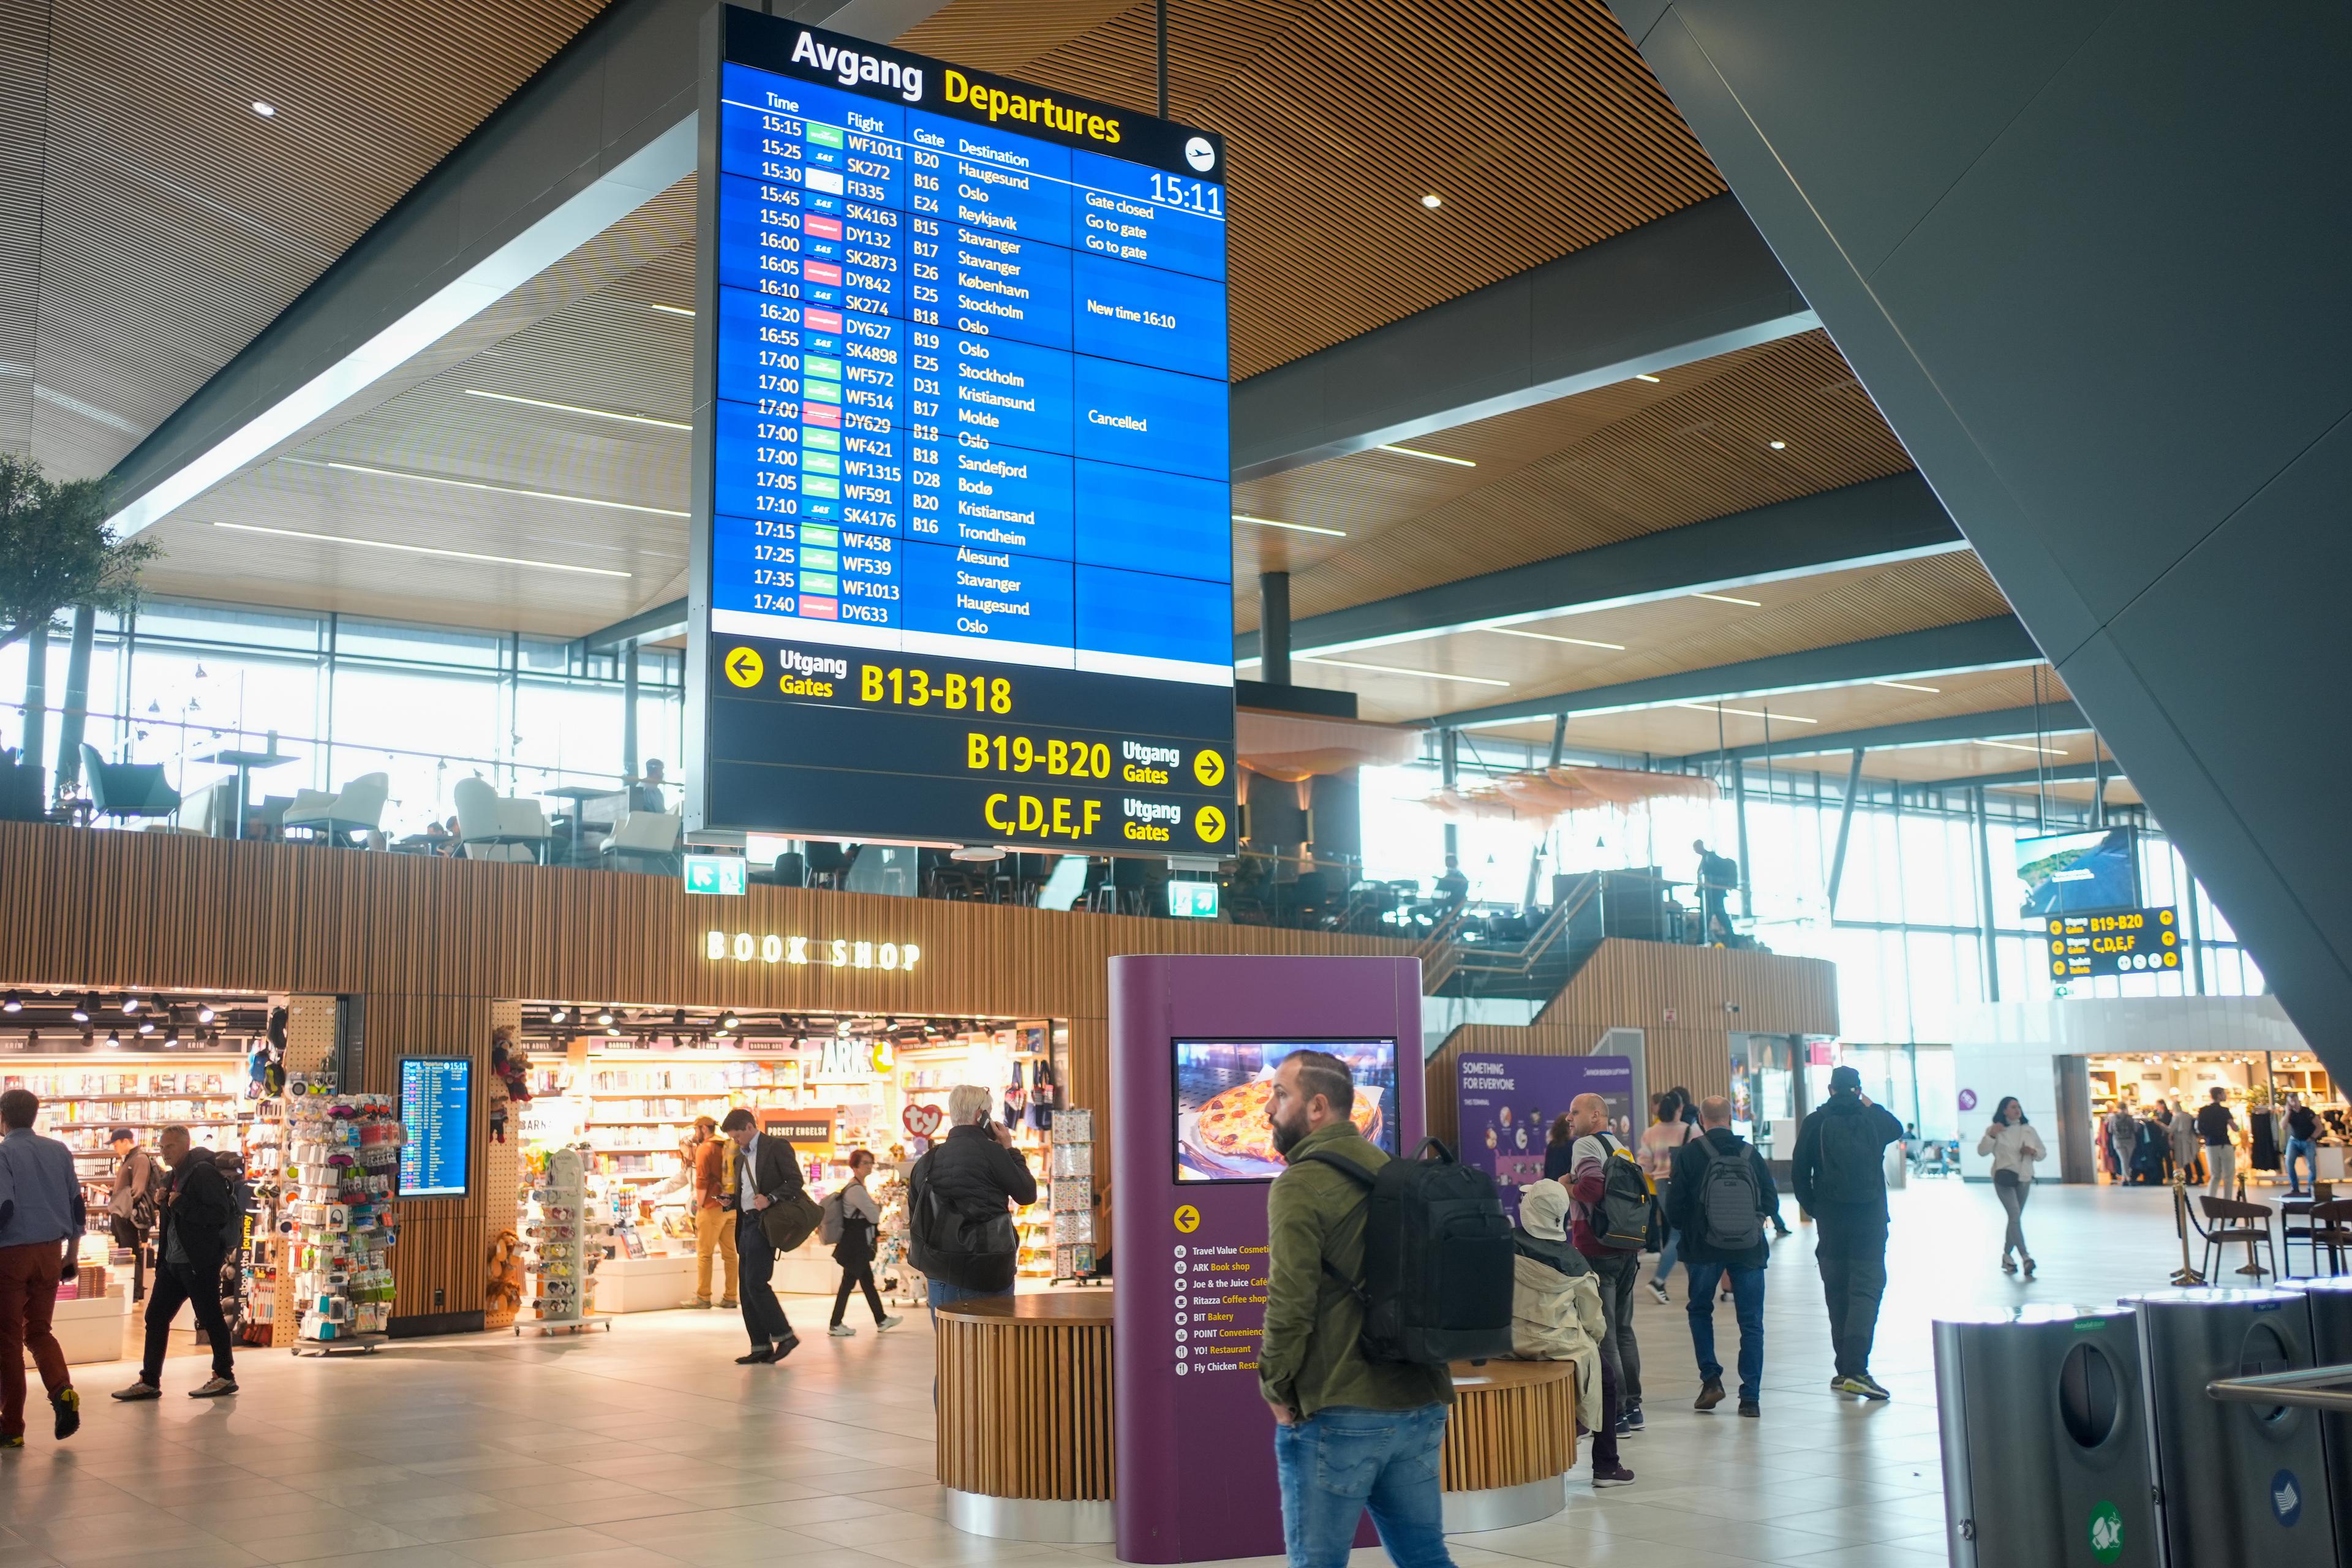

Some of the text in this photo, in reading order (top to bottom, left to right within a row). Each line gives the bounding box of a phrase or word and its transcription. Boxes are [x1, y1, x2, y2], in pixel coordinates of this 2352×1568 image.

[791, 31, 1121, 143] Avgang Departures
[767, 92, 1028, 167] Time Flight Gate Destination
[763, 116, 801, 136] 15:15
[848, 135, 903, 160] WF1011
[915, 151, 939, 168] B20
[959, 162, 1029, 189] Haugesund
[1086, 192, 1114, 209] Gate
[1117, 201, 1154, 219] closed
[763, 139, 1147, 238] 15:25 SK272 B16 Oslo Go to gate
[763, 162, 1147, 259] 15:30 FI335 E24 Reykjavik Go to gate
[1150, 173, 1223, 216] 15:11
[761, 186, 1020, 254] 15:45 SK4163 B15 Stavanger
[761, 209, 799, 228] 15:50
[847, 227, 891, 248] DY132
[914, 241, 938, 257] B17
[959, 251, 1020, 276] Stavanger
[761, 232, 1175, 328] 16:00 SK2873 E26 København New time 16:10
[761, 255, 799, 274] 16:05
[846, 272, 890, 293] DY842
[914, 285, 938, 302] E25
[959, 295, 1023, 319] Stockholm
[760, 279, 989, 334] 16:10 SK274 B18 Oslo
[761, 304, 799, 323] 16:20
[847, 319, 891, 339] DY627
[914, 332, 939, 349] B19
[959, 341, 989, 358] Oslo
[760, 327, 1024, 387] 16:55 SK4898 E25 Stockholm
[760, 351, 1147, 431] 17:00 WF572 D31 Kristiansund Cancelled
[760, 374, 799, 393] 17:00
[846, 389, 893, 410] WF514
[914, 401, 938, 417] B17
[959, 409, 999, 428] Molde
[759, 399, 798, 418] 17:00
[845, 413, 891, 433] DY629
[914, 424, 938, 441] B18
[959, 432, 989, 449] Oslo
[758, 424, 797, 442] 17:00
[845, 437, 892, 457] WF421
[914, 448, 938, 464] B18
[959, 455, 1027, 478] Sandefjord
[758, 448, 797, 466] 17:00
[845, 461, 901, 481] WF1315
[914, 470, 940, 487] D28
[959, 478, 992, 495] Bodø
[757, 472, 796, 490] 17:05
[845, 484, 892, 504] WF591
[914, 494, 938, 510] B20
[959, 500, 1035, 524] Kristiansand
[755, 521, 795, 539] 17:15
[843, 532, 891, 552] WF458
[957, 545, 1009, 567] Ålesund
[757, 496, 1025, 548] 17:10 SK4176 B16 Trondheim
[755, 545, 794, 563] 17:25
[843, 556, 891, 575] WF539
[957, 571, 1020, 593] Stavanger
[755, 570, 794, 587] 17:35
[843, 580, 899, 600] WF1013
[957, 594, 1030, 615] Haugesund
[755, 594, 794, 611] 17:40
[843, 604, 888, 622] DY633
[957, 617, 988, 633] Oslo
[780, 650, 846, 679] Utgang
[780, 665, 1011, 714] Gates B13-B18
[968, 733, 1179, 778] B19-B20 Utgang
[1123, 764, 1168, 784] Gates
[985, 794, 1180, 839] C,D,E,F Utgang
[1124, 822, 1169, 841] Gates
[2090, 914, 2143, 932] B19-B20
[707, 931, 920, 971] BOOK SHOP
[821, 1040, 872, 1073] ARK
[1463, 1062, 1504, 1075] SOMETHING
[1463, 1077, 1515, 1090] FOR EVERYONE
[767, 1126, 827, 1137] POCKET ENGELSK
[905, 1107, 938, 1135] ty
[241, 1215, 254, 1251] journey
[1193, 1246, 1215, 1255] Travel
[1239, 1245, 1269, 1254] Cosmeti
[1216, 1279, 1228, 1287] the
[1232, 1262, 1250, 1272] shop
[1208, 1313, 1234, 1322] Bakery
[1249, 1295, 1267, 1304] shop
[1194, 1363, 1205, 1373] Fly
[1207, 1362, 1237, 1371] Chicken
